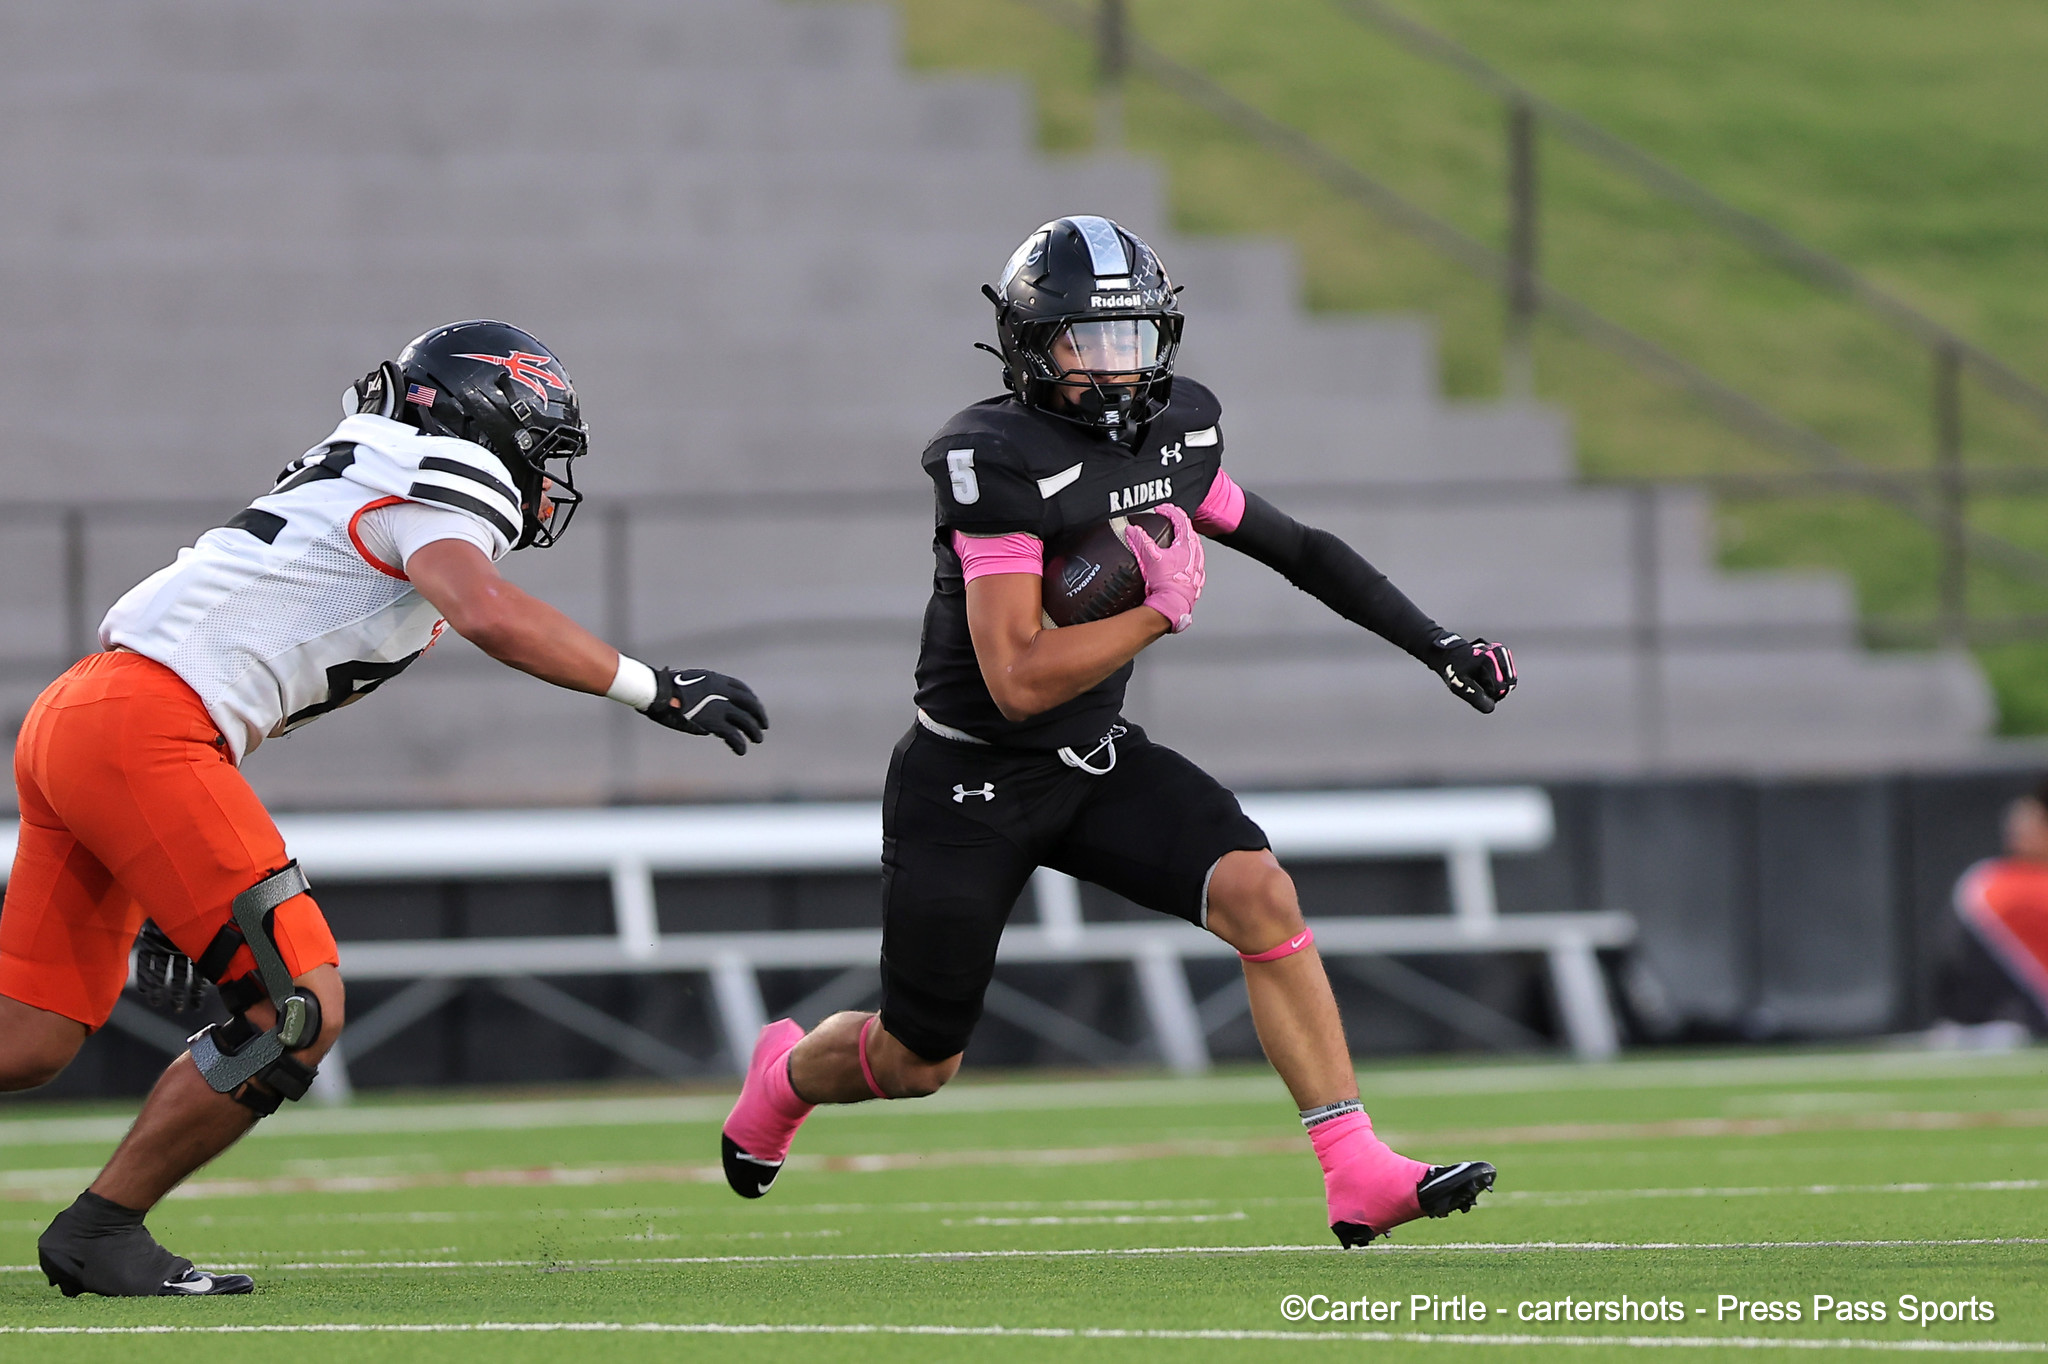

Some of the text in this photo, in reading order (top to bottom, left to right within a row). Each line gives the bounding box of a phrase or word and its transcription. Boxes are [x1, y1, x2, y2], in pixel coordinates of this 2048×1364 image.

[1090, 294, 1142, 308] Riddell
[946, 448, 981, 506] 5
[1108, 476, 1174, 514] RAIDERS
[1065, 562, 1102, 598] RANDALL
[1325, 1102, 1342, 1112] ONE
